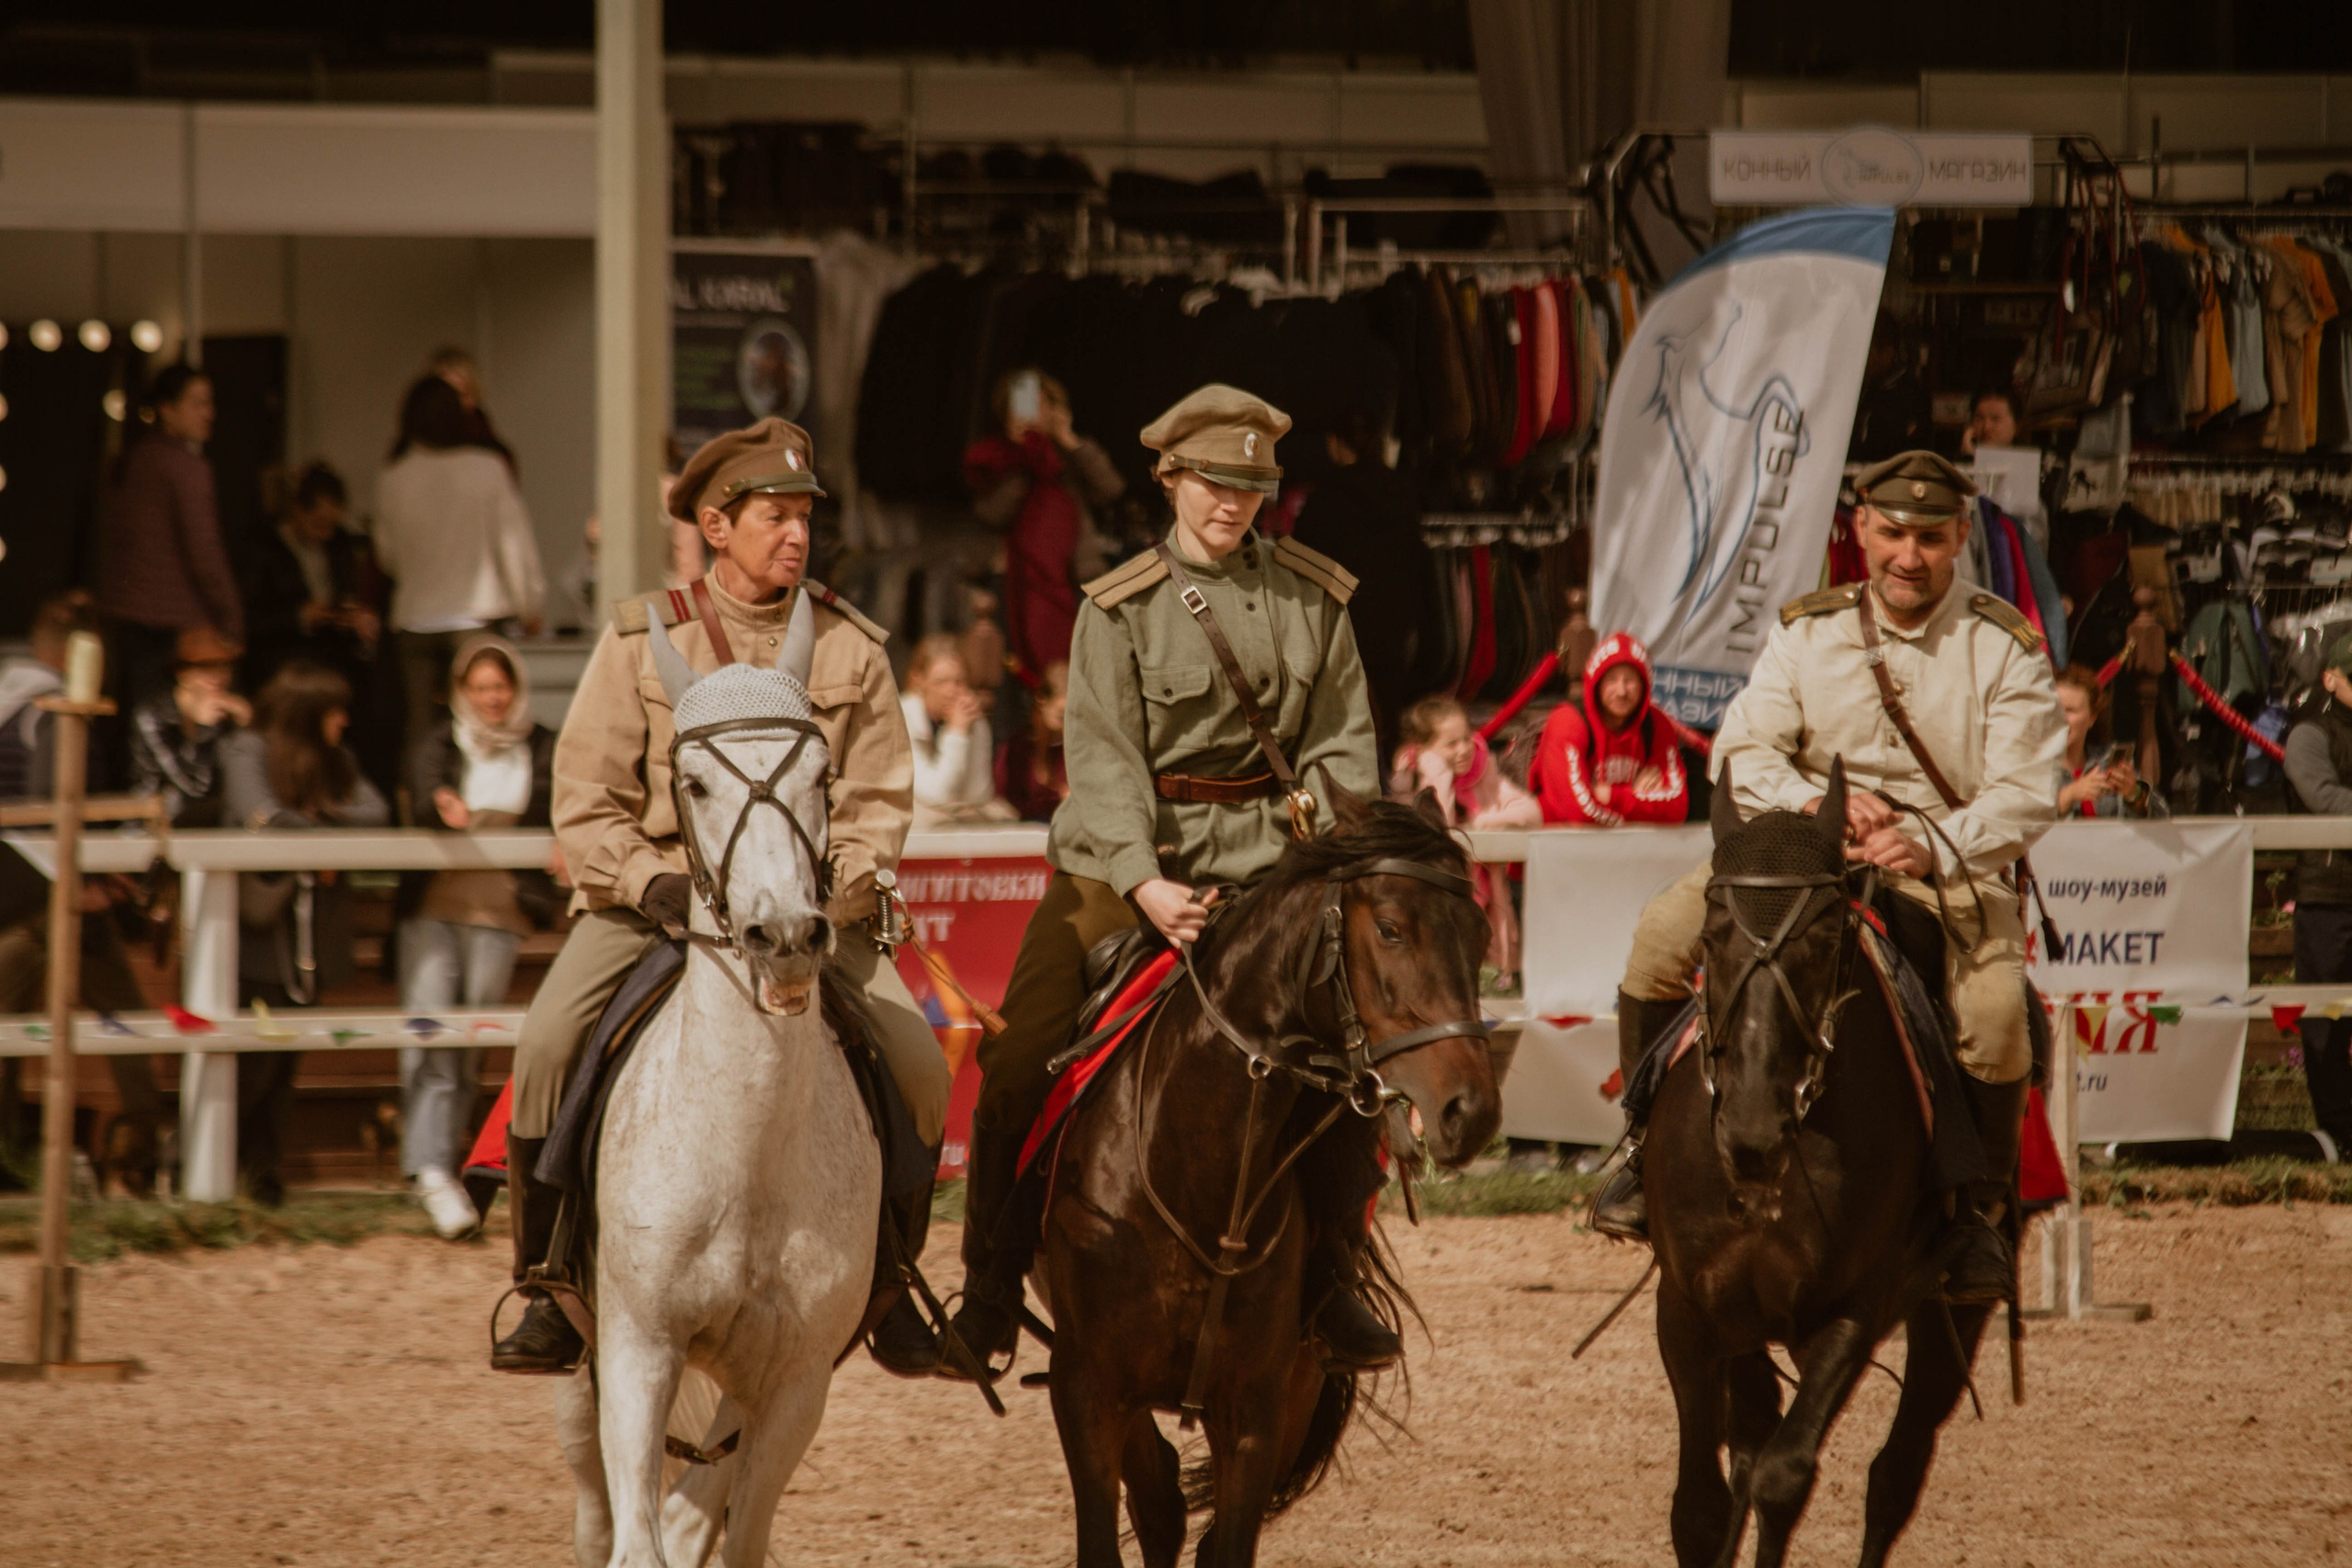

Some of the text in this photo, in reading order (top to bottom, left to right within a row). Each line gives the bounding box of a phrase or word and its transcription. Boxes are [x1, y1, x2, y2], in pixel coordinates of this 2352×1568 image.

[1724, 154, 2027, 184] КОННЫЙ МАГАЗИН
[1725, 402, 1805, 653] IMPULSE
[1653, 669, 1745, 700] ННЫЙ
[2048, 874, 2167, 905] шоу-музей
